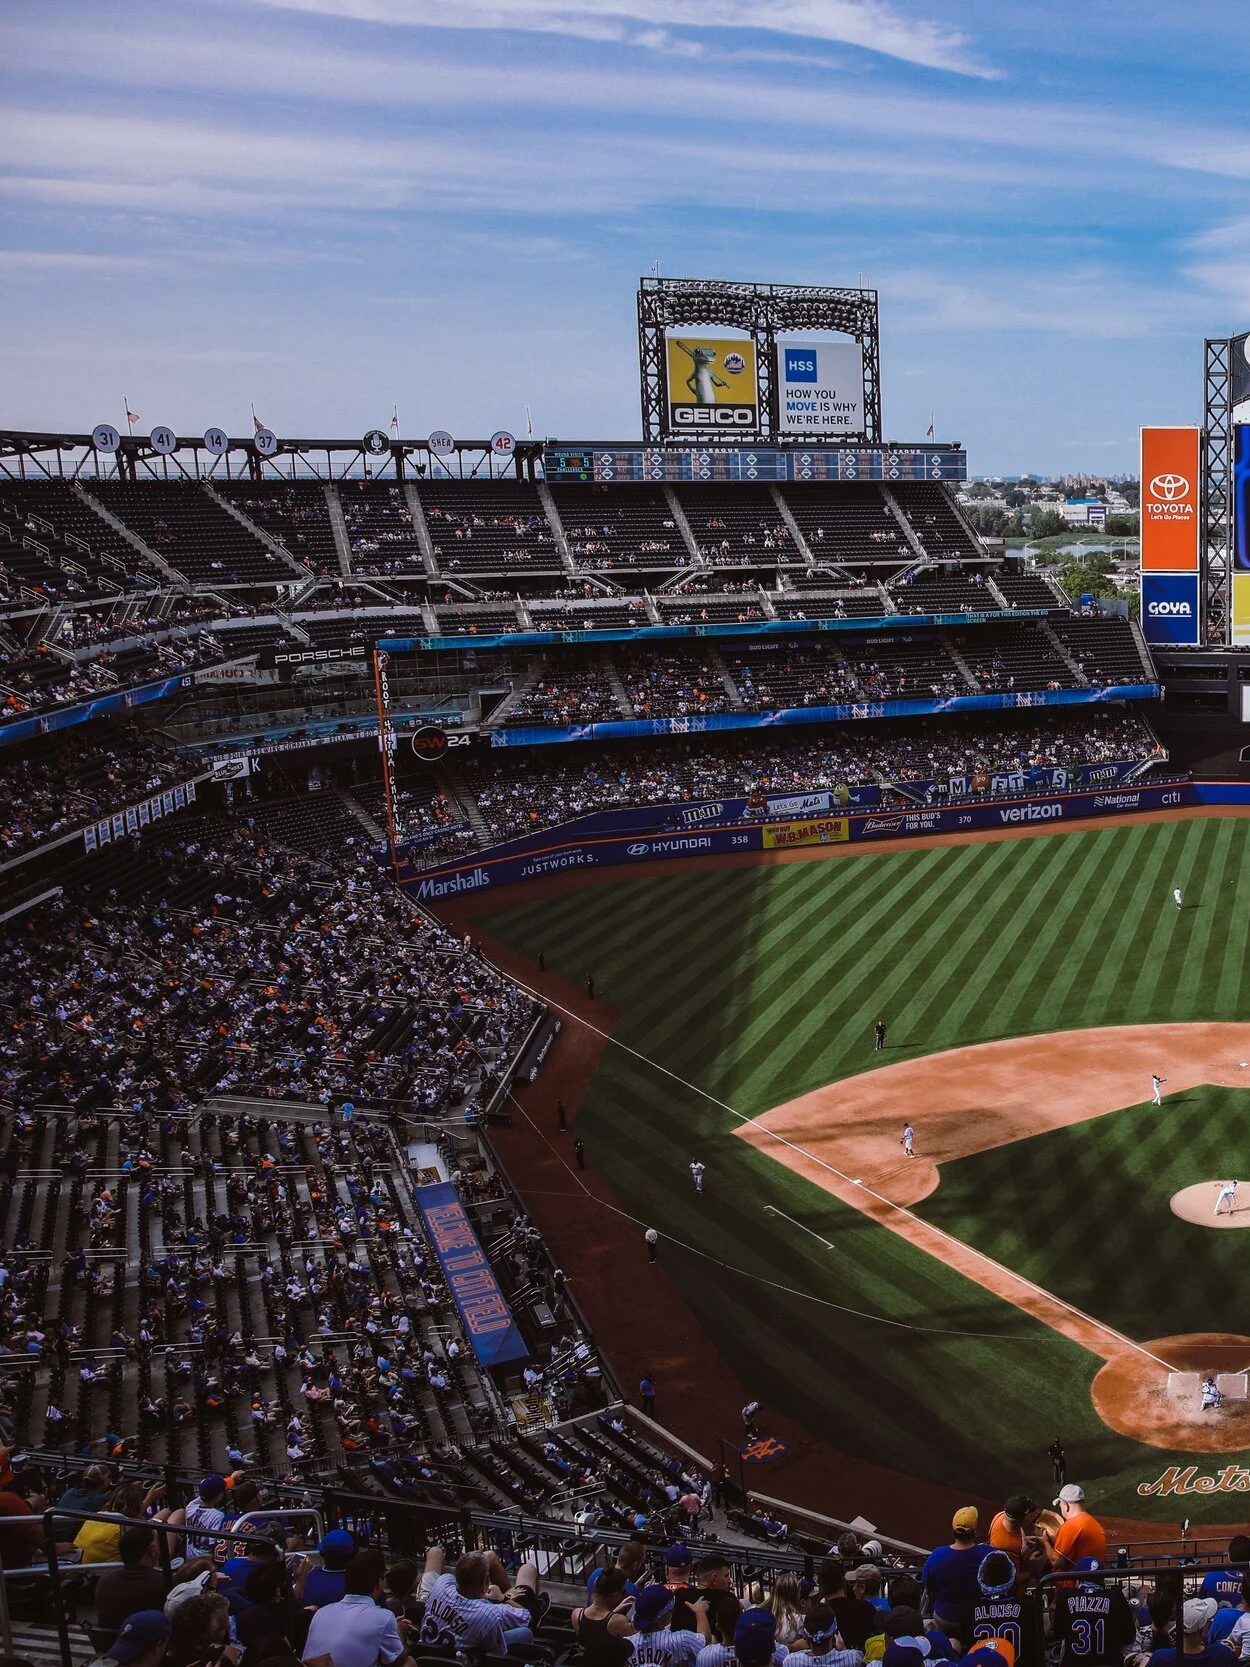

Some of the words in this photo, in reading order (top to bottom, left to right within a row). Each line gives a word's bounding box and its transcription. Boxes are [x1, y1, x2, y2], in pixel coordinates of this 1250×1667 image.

[788, 359, 814, 371] HSS
[786, 389, 812, 399] HOW
[814, 389, 836, 400] YOU
[786, 401, 817, 411] MOVE
[819, 402, 829, 411] IS
[832, 402, 857, 412] WHY
[674, 407, 752, 424] GEICO
[786, 414, 819, 424] WE'RE
[822, 415, 853, 425] HERE.
[99, 432, 114, 446] 31
[157, 433, 170, 447] 41
[210, 434, 222, 447] 14
[258, 435, 273, 449] 37
[431, 438, 451, 447] SHEA
[495, 437, 511, 449] 42
[559, 457, 566, 468] 5
[583, 457, 590, 468] 5
[1146, 503, 1194, 513] TOYOTA
[1148, 601, 1191, 614] GOYA
[275, 646, 366, 664] PORSCHE
[181, 676, 192, 687] 453
[447, 735, 471, 747] 24
[252, 758, 261, 773] K
[1103, 793, 1140, 805] National
[1161, 791, 1181, 804] citi
[773, 802, 787, 811] Let's
[787, 801, 798, 809] Go
[1000, 803, 1062, 822] verizon
[905, 814, 919, 822] THIS
[920, 811, 941, 821] BUD'S
[958, 815, 972, 824] 370
[434, 826, 450, 835] CASINO
[866, 819, 902, 831] Budweiser
[905, 821, 918, 830] FOR
[919, 820, 935, 829] YOU.
[652, 837, 712, 852] HYUNDAI
[731, 835, 749, 845] 358
[521, 853, 599, 877] JUSTWORKS.
[416, 868, 490, 899] Marshalls
[424, 1202, 477, 1253] WELCOME
[444, 1250, 485, 1271] TO
[452, 1269, 496, 1298] CITI
[460, 1293, 511, 1335] FIELD
[1067, 1595, 1111, 1614] PIAZZA
[420, 1599, 469, 1635] ALONSO
[974, 1603, 1021, 1621] ALONSO
[1072, 1618, 1105, 1656] 31
